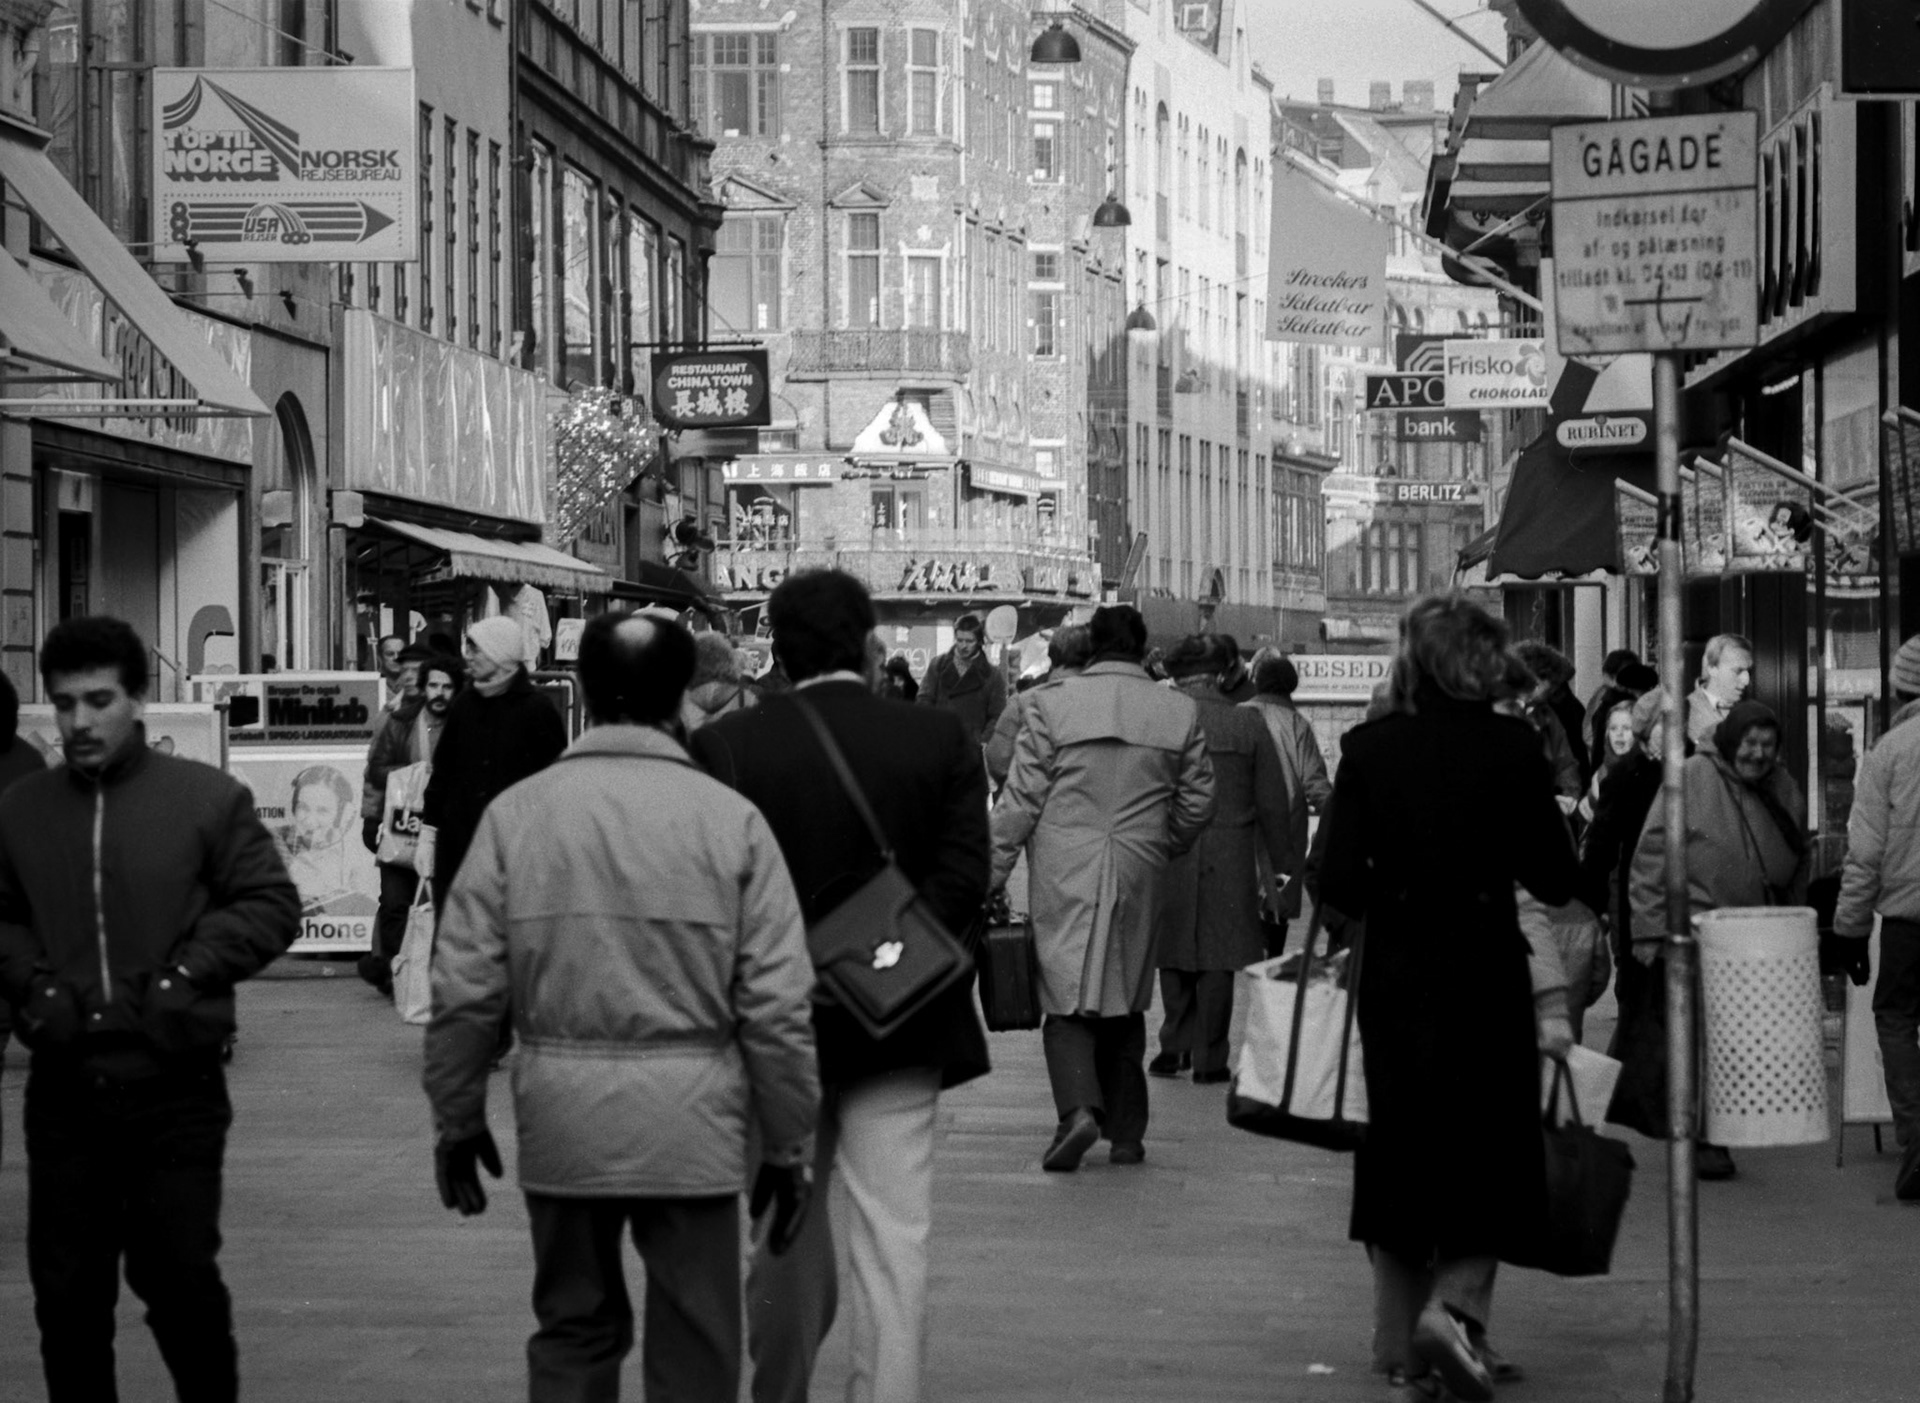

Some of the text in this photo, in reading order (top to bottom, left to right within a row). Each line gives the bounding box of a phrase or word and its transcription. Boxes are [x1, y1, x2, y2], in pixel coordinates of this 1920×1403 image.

[219, 130, 256, 148] TIL
[163, 149, 275, 176] NORGE
[301, 150, 400, 168] NORSK
[1583, 133, 1722, 177] GÅGADE
[301, 169, 402, 181] REJSEBUREAU
[244, 217, 279, 233] USA
[243, 233, 278, 242] REJSER
[1279, 292, 1373, 314] Salatbar
[1278, 315, 1372, 336] Salatbar
[671, 363, 748, 375] RESTAURANT
[1448, 355, 1513, 375] Frisko
[667, 374, 753, 388] CHINA TOWN
[1404, 416, 1456, 436] bank
[1567, 423, 1639, 441] RUBINET
[1398, 484, 1462, 501] BERLITZ
[714, 563, 796, 590] ANG
[268, 697, 369, 726] Minilab
[256, 807, 286, 819] ATION
